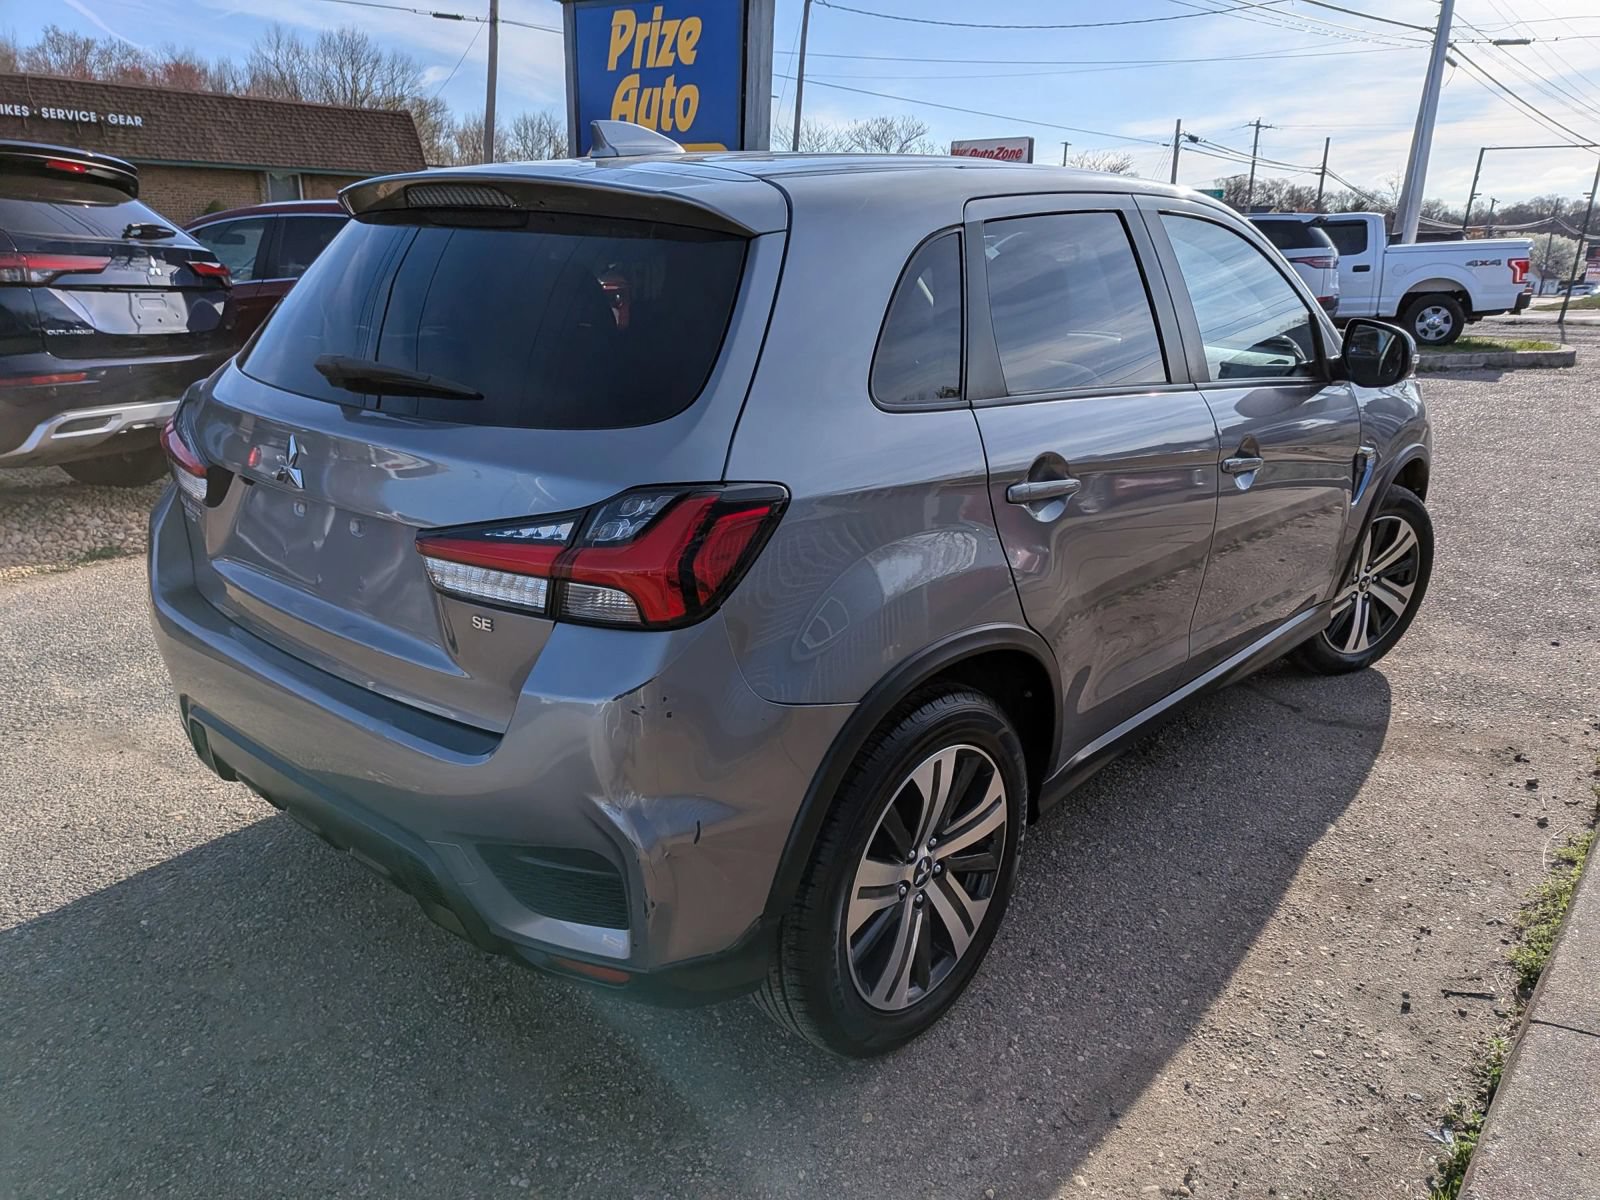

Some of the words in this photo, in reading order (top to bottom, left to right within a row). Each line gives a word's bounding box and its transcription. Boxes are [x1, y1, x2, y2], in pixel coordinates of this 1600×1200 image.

[607, 5, 702, 71] Prize
[610, 73, 700, 132] Auto
[41, 107, 97, 122] SERVICE
[107, 113, 143, 127] GEAR
[969, 146, 1023, 160] AutoZone
[472, 615, 492, 632] SE
